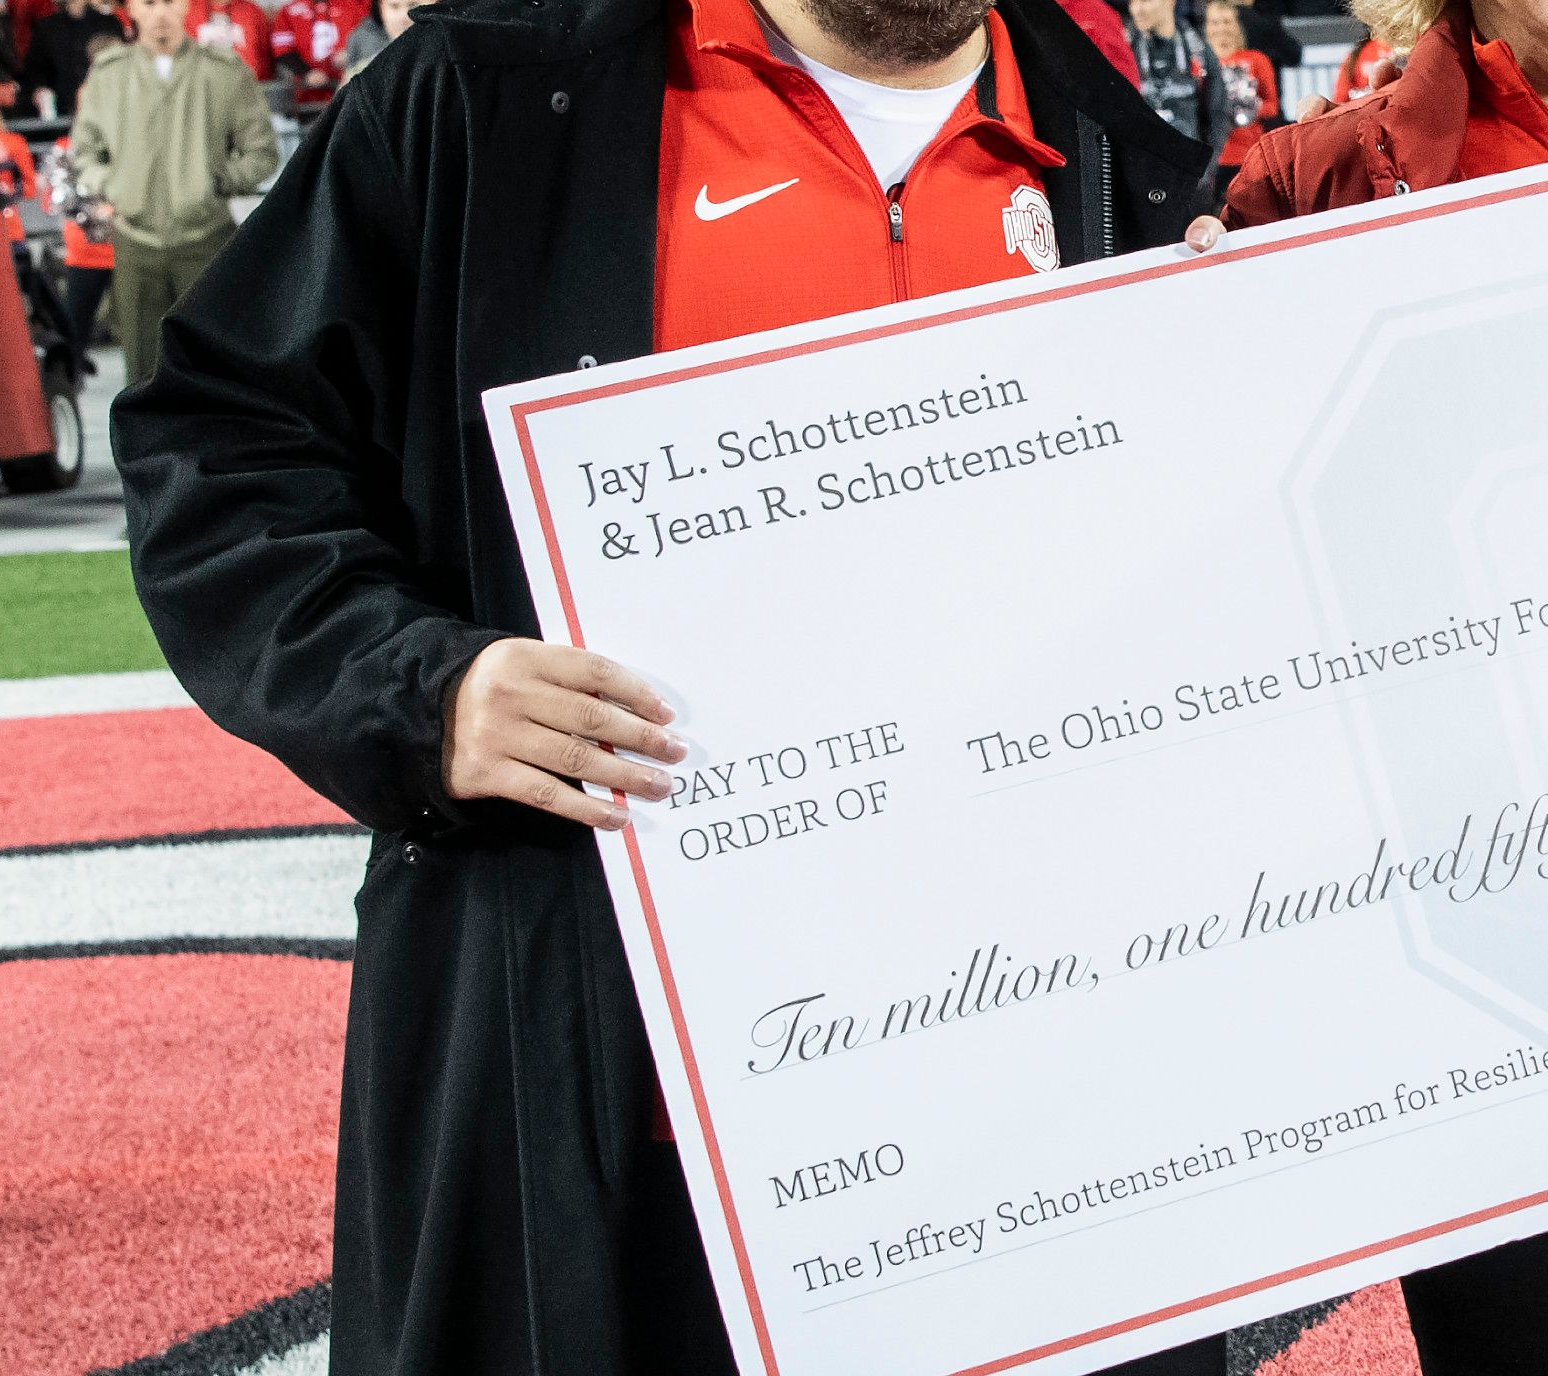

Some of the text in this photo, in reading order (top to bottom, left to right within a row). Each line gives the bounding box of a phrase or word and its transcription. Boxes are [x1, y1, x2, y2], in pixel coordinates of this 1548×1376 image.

[576, 372, 1030, 509] Jay L. Schottenstein
[600, 413, 1125, 561] & Jean R. Schottenstein
[965, 730, 1052, 775] The
[1060, 698, 1165, 751] Ohio
[1173, 673, 1283, 723] State
[1287, 614, 1506, 693] University
[667, 721, 906, 811] PAY TO THE
[678, 779, 892, 863] ORDER OF
[746, 991, 871, 1076] Ten
[880, 942, 1100, 1041] million,
[1124, 913, 1229, 972] one
[1239, 813, 1474, 942] hundred
[767, 1142, 905, 1210] MEMO
[791, 1254, 865, 1293] The
[867, 1217, 987, 1279] Jeffrey
[995, 1142, 1239, 1234] Schottenstein
[1239, 1100, 1389, 1162] Program
[1393, 1082, 1441, 1117] for
